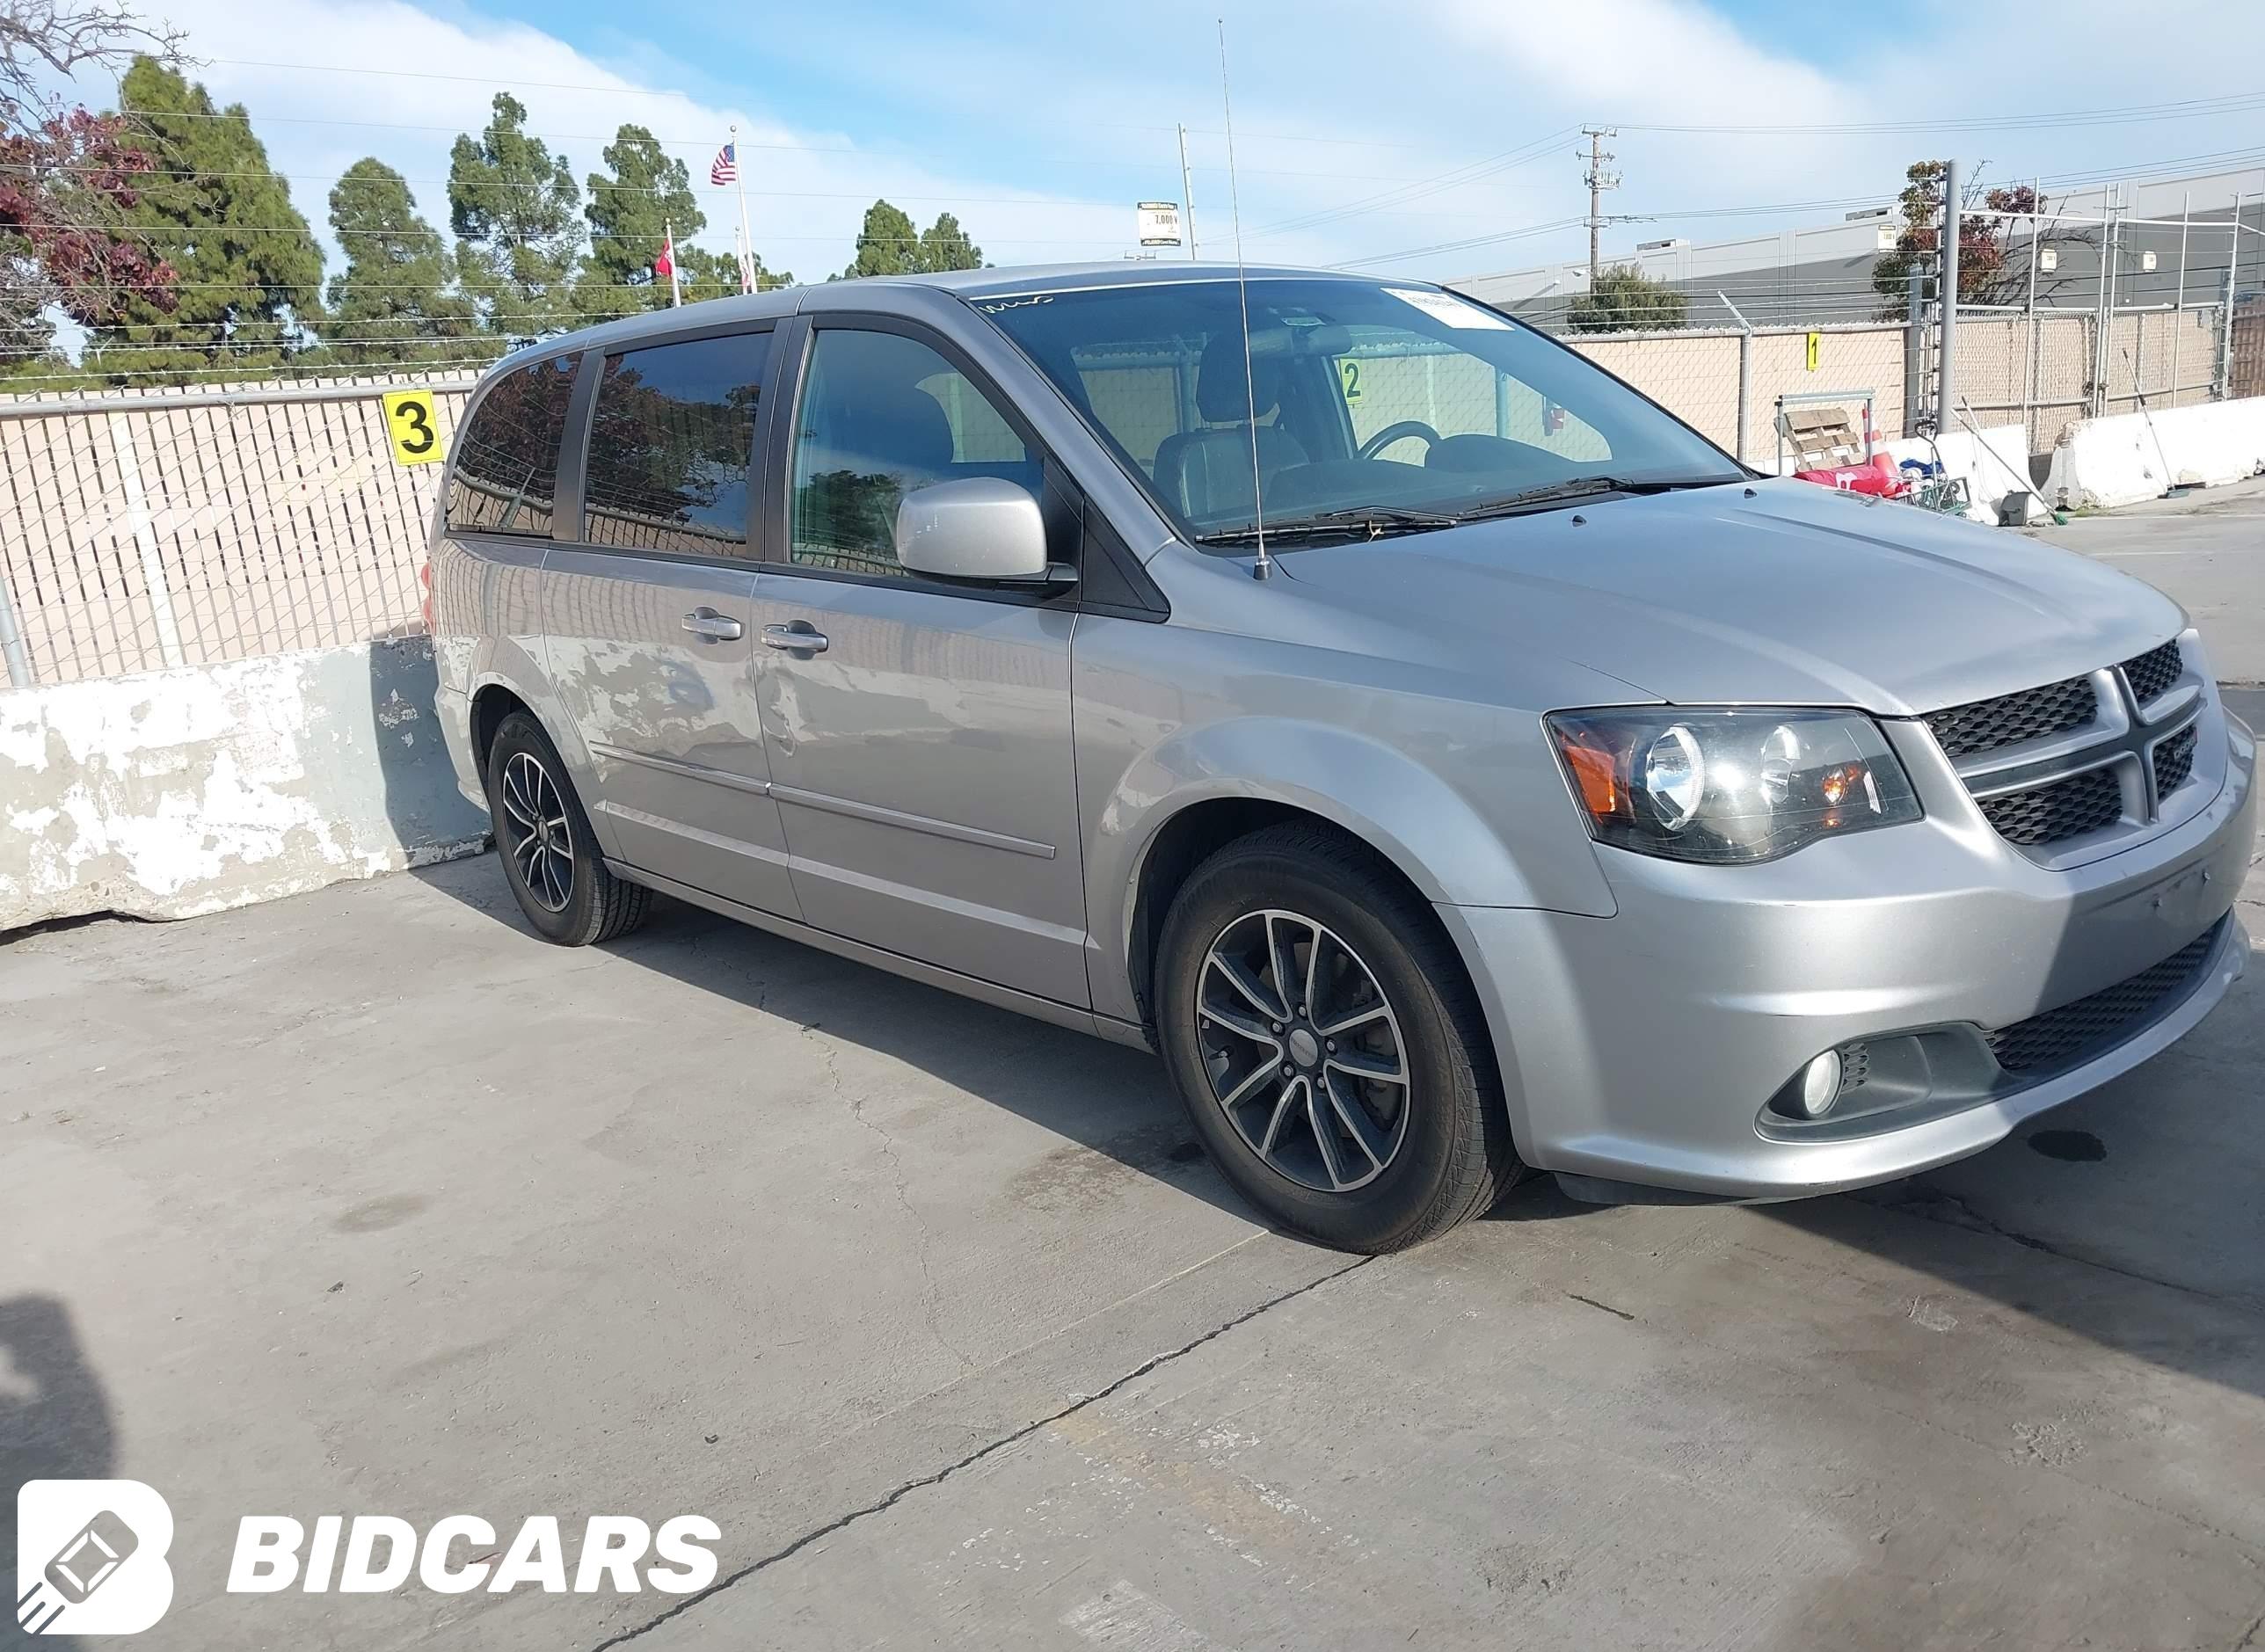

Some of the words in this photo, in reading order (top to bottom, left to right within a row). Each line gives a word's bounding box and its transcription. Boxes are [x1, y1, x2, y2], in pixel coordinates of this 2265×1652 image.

[1811, 338, 1817, 364] 1
[1344, 363, 1361, 397] 2
[395, 401, 434, 454] 3
